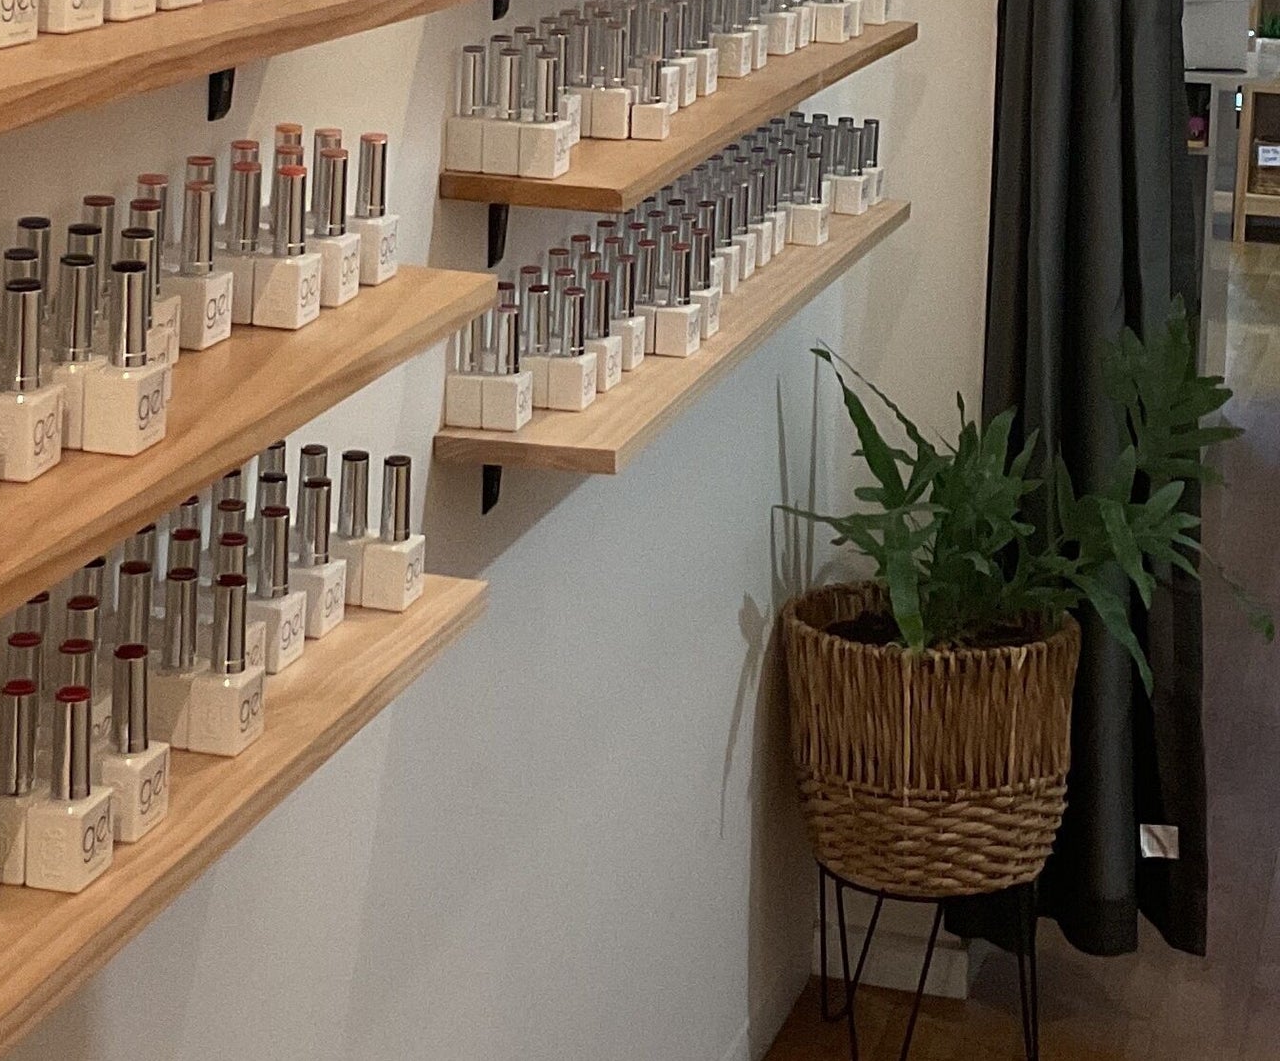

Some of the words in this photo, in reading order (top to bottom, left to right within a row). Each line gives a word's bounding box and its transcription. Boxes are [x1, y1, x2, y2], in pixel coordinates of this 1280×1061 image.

[206, 278, 230, 329] gel
[33, 393, 60, 456] gel
[139, 370, 165, 430] gel
[140, 753, 167, 815] gel
[83, 795, 111, 862] gel
